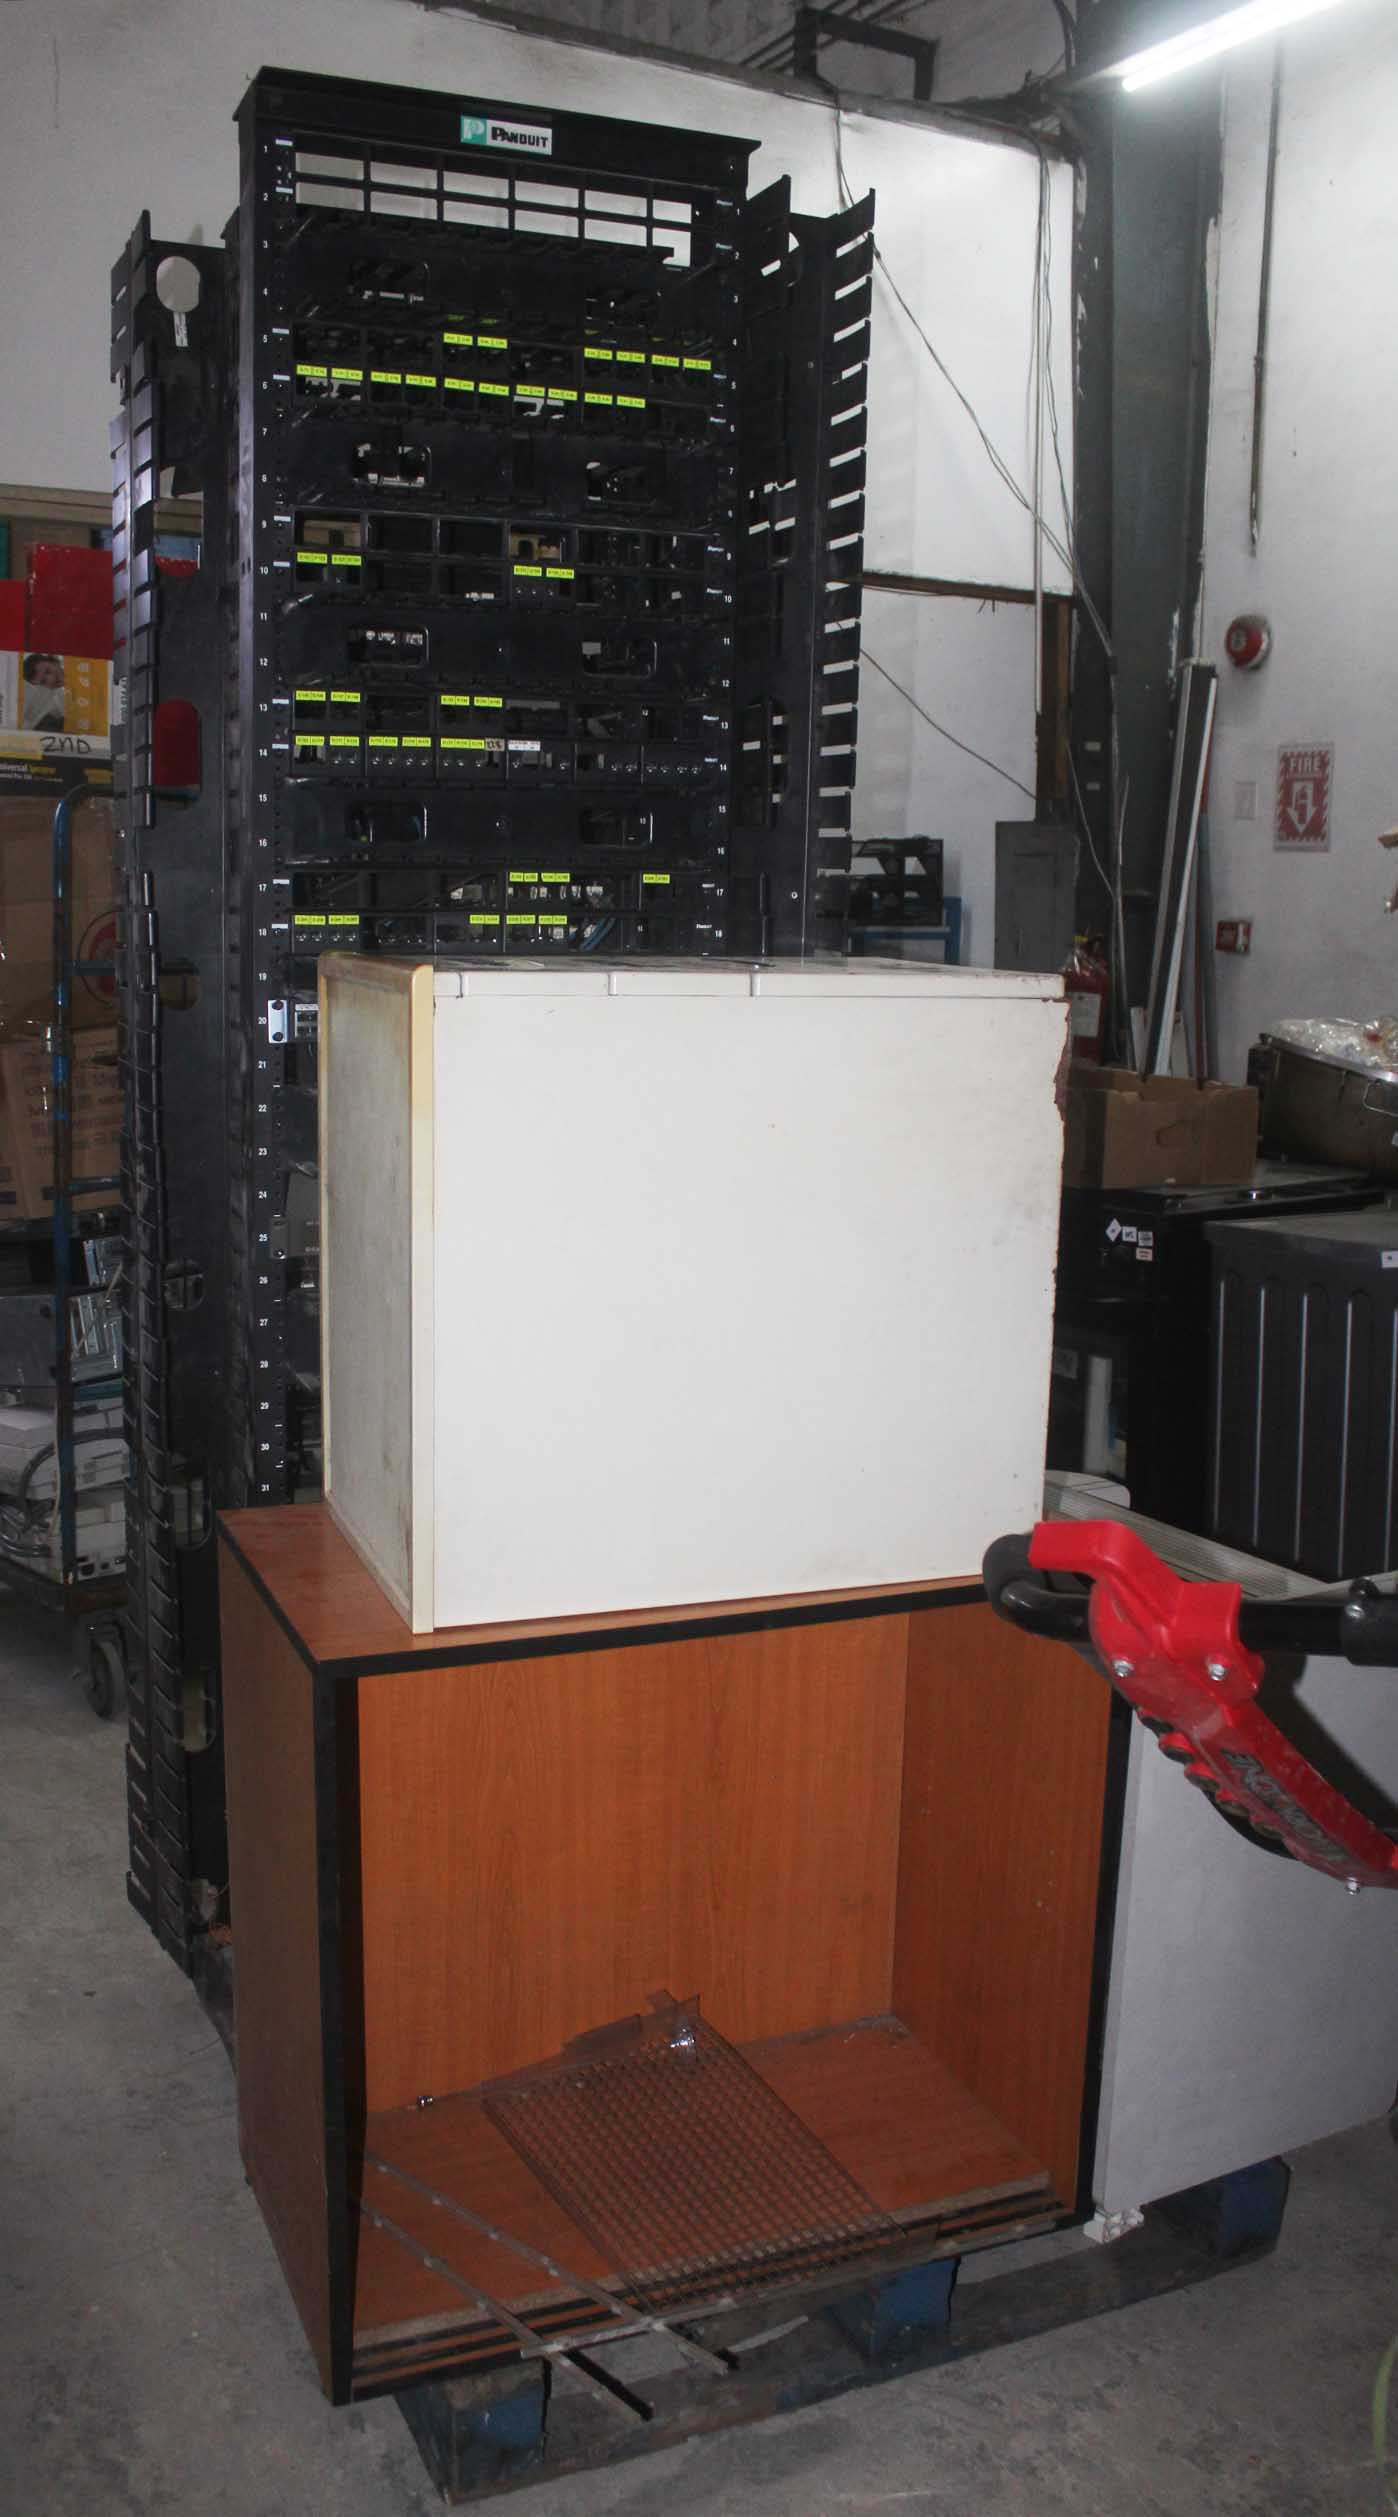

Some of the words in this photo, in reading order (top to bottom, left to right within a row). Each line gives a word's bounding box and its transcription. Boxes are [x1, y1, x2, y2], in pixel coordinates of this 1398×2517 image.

[491, 126, 548, 148] PANDUIT
[263, 145, 268, 153] 1
[263, 192, 269, 202] 2
[263, 287, 268, 296] 4
[262, 334, 268, 343] 5
[262, 381, 268, 390] 6
[262, 427, 268, 436] 7
[261, 473, 268, 483] 8
[261, 519, 267, 529] 9
[259, 566, 269, 575] 10
[723, 595, 733, 604] 10
[260, 612, 268, 621] 11
[723, 637, 730, 646] 11
[259, 657, 268, 667] 12
[259, 703, 268, 712] 13
[720, 721, 729, 730] 13
[259, 748, 268, 757] 14
[719, 763, 727, 772] 14
[1289, 757, 1321, 773] FIRE
[258, 793, 268, 803] 15
[258, 838, 268, 847] 16
[258, 883, 267, 892] 17
[716, 888, 724, 897] 17
[258, 927, 267, 937] 18
[258, 972, 268, 981] 19
[258, 1016, 268, 1026] 20
[258, 1060, 267, 1069] 21
[258, 1103, 267, 1113] 22
[258, 1147, 268, 1156] 23
[258, 1191, 267, 1199] 24
[258, 1233, 268, 1242] 25
[259, 1318, 269, 1327] 27
[260, 1401, 270, 1410] 29
[260, 1442, 270, 1451] 30
[261, 1483, 270, 1492] 31
